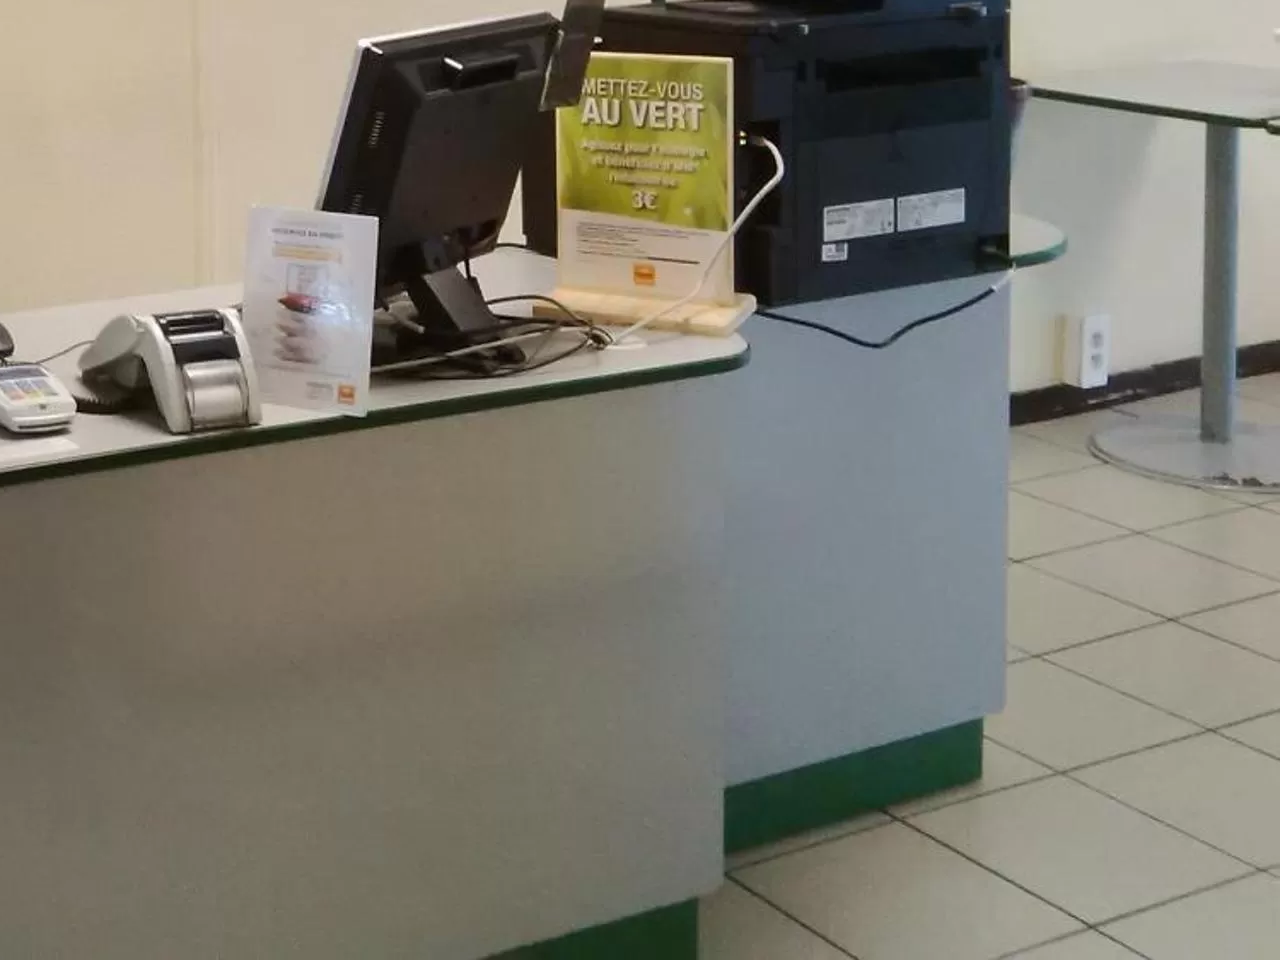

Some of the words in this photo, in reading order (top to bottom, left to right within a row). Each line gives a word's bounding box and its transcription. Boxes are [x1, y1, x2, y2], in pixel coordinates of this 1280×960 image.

[582, 78, 704, 101] METTEZ-VOUS
[581, 98, 620, 126] AU
[629, 100, 705, 131] VERT
[631, 190, 659, 210] 3€
